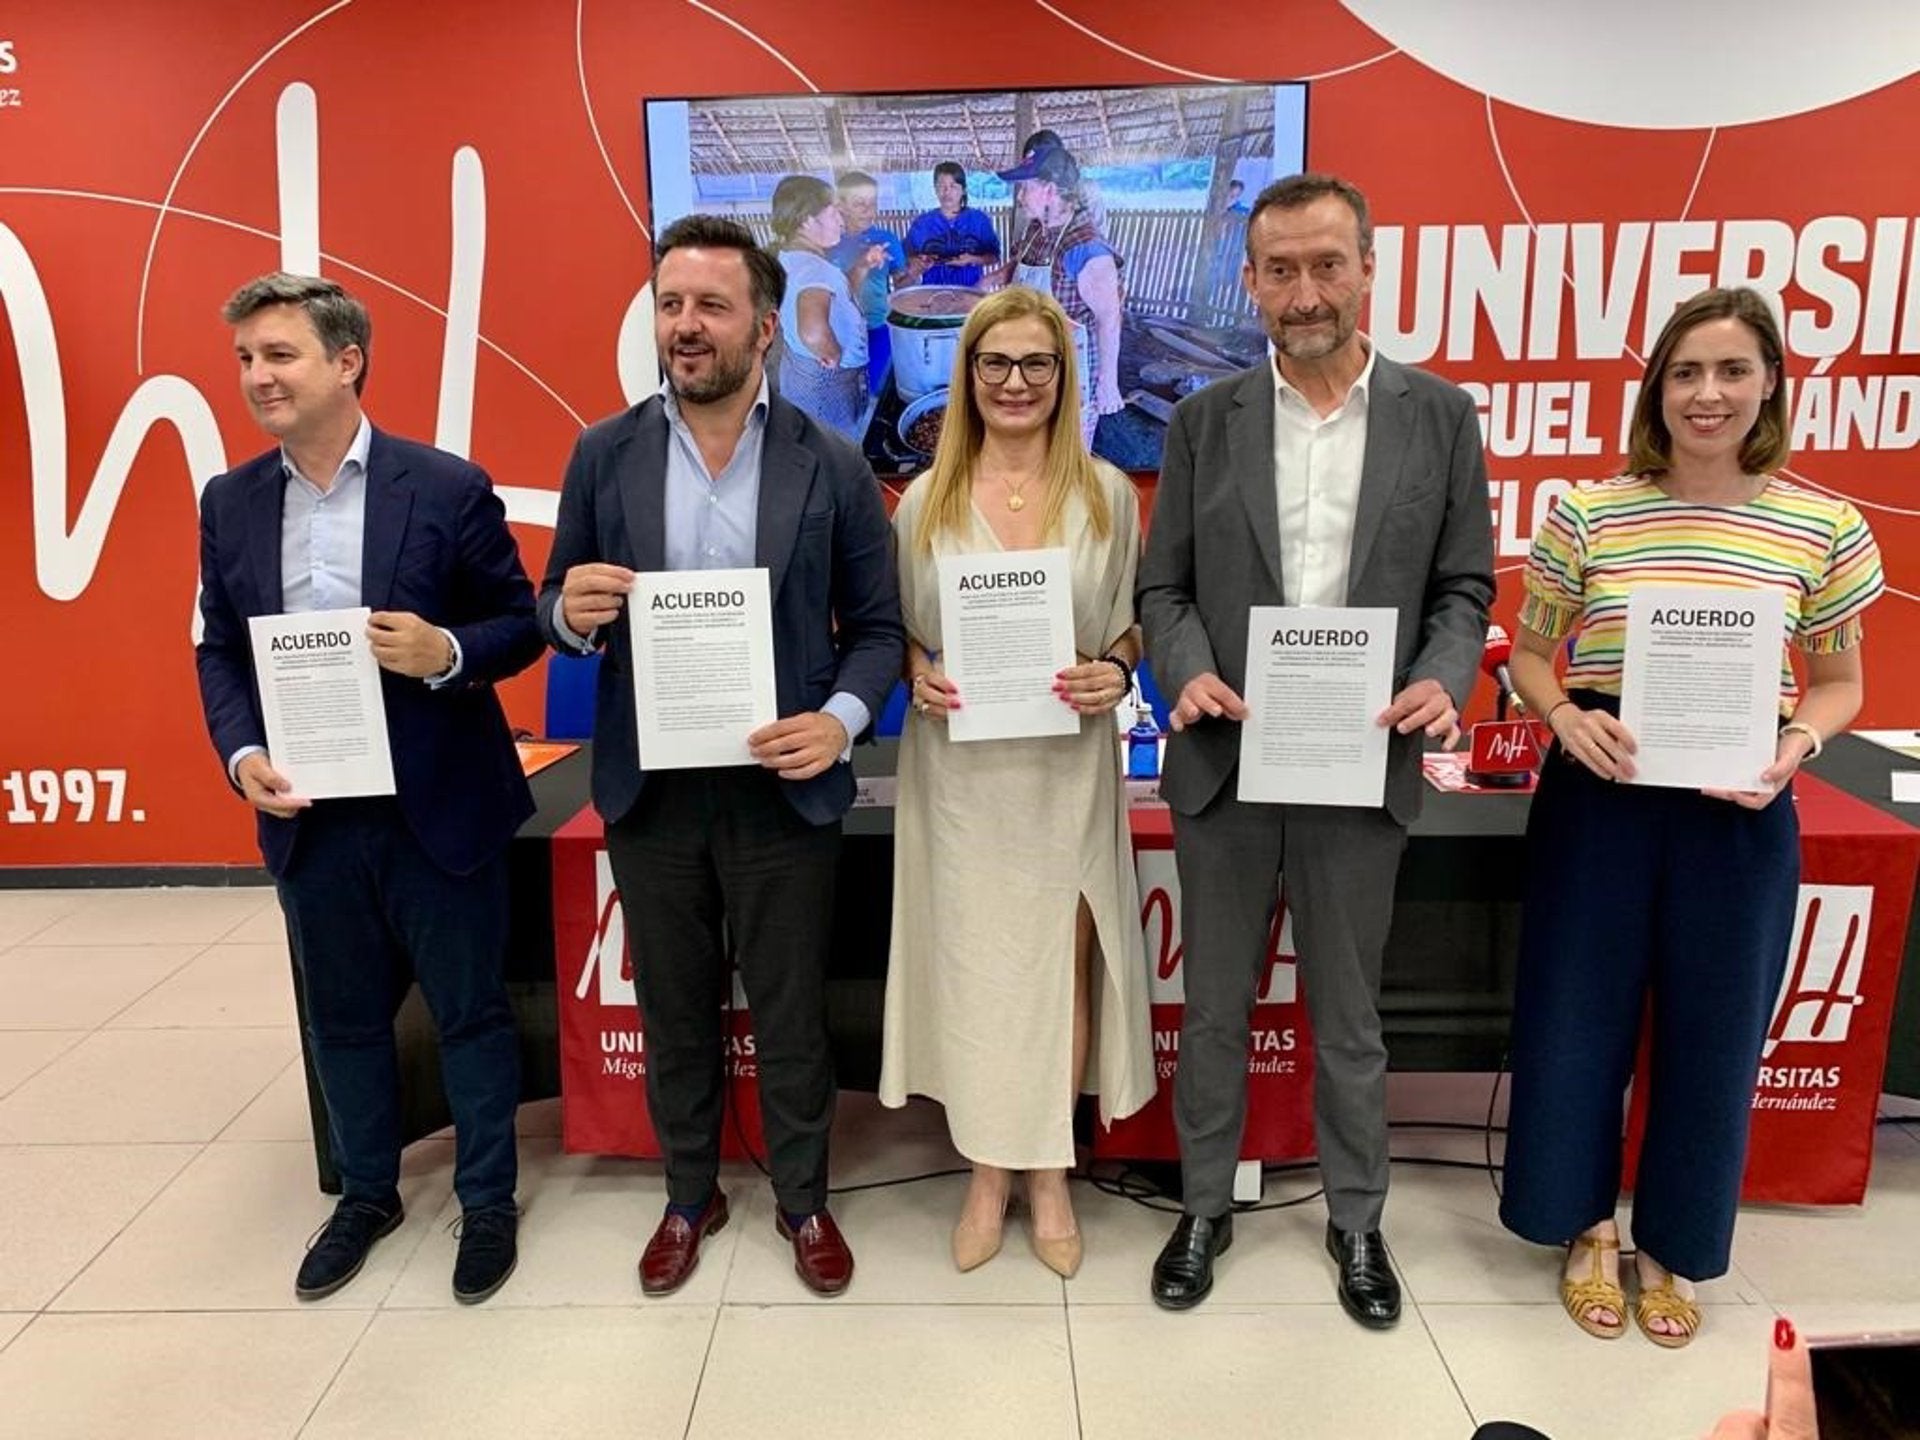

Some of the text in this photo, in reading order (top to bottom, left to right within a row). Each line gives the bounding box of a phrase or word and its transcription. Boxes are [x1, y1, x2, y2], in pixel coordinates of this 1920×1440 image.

[1369, 215, 1920, 364] UNIVERSI
[959, 570, 1046, 591] ACUERDO
[651, 590, 745, 610] ACUERDO
[1650, 609, 1755, 627] ACUERDO
[270, 631, 352, 651] ACUERDO
[1270, 630, 1370, 646] ACUERDO
[2, 769, 146, 824] 1997.
[1757, 1066, 1841, 1089] RSITAS
